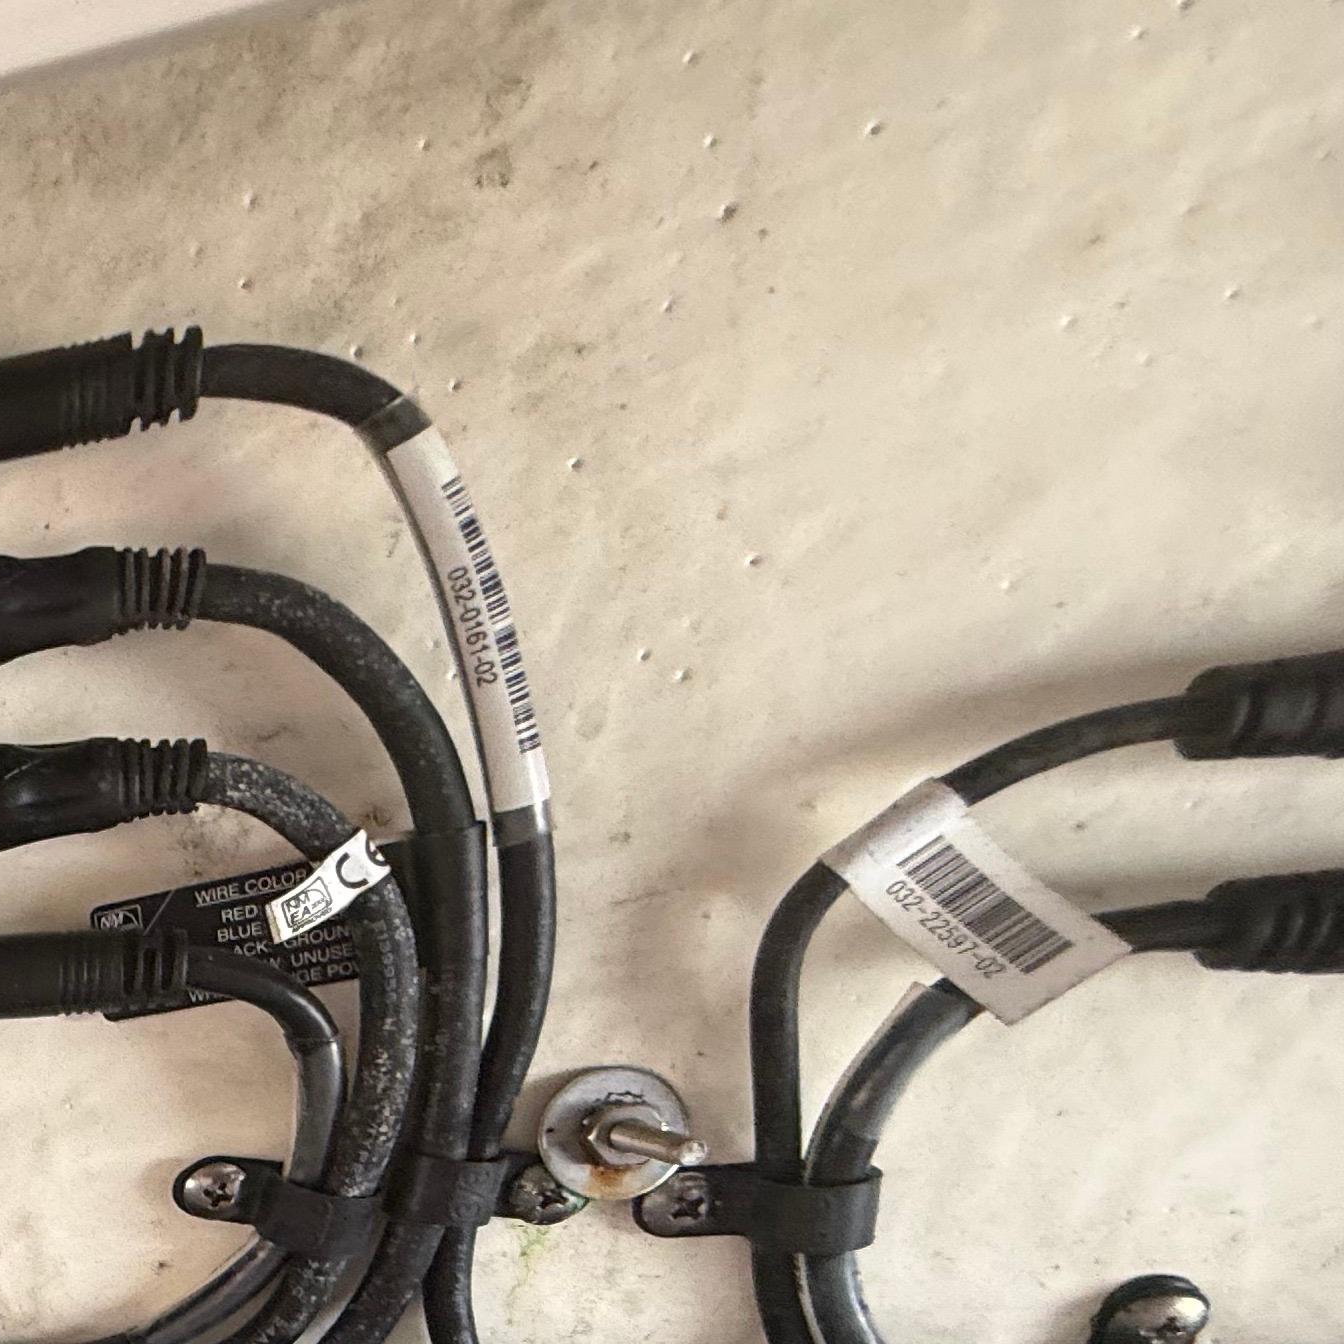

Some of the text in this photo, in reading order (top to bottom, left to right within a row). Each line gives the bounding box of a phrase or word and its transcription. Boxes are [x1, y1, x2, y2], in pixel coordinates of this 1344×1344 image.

[447, 567, 498, 688] 032-0161-02
[194, 882, 242, 904] WIRE
[221, 905, 257, 924] RED
[217, 922, 262, 943] BLUE
[233, 924, 351, 957] ACK GROUN
[886, 880, 1007, 979] 032-22597-02
[291, 943, 353, 967] UNUSE
